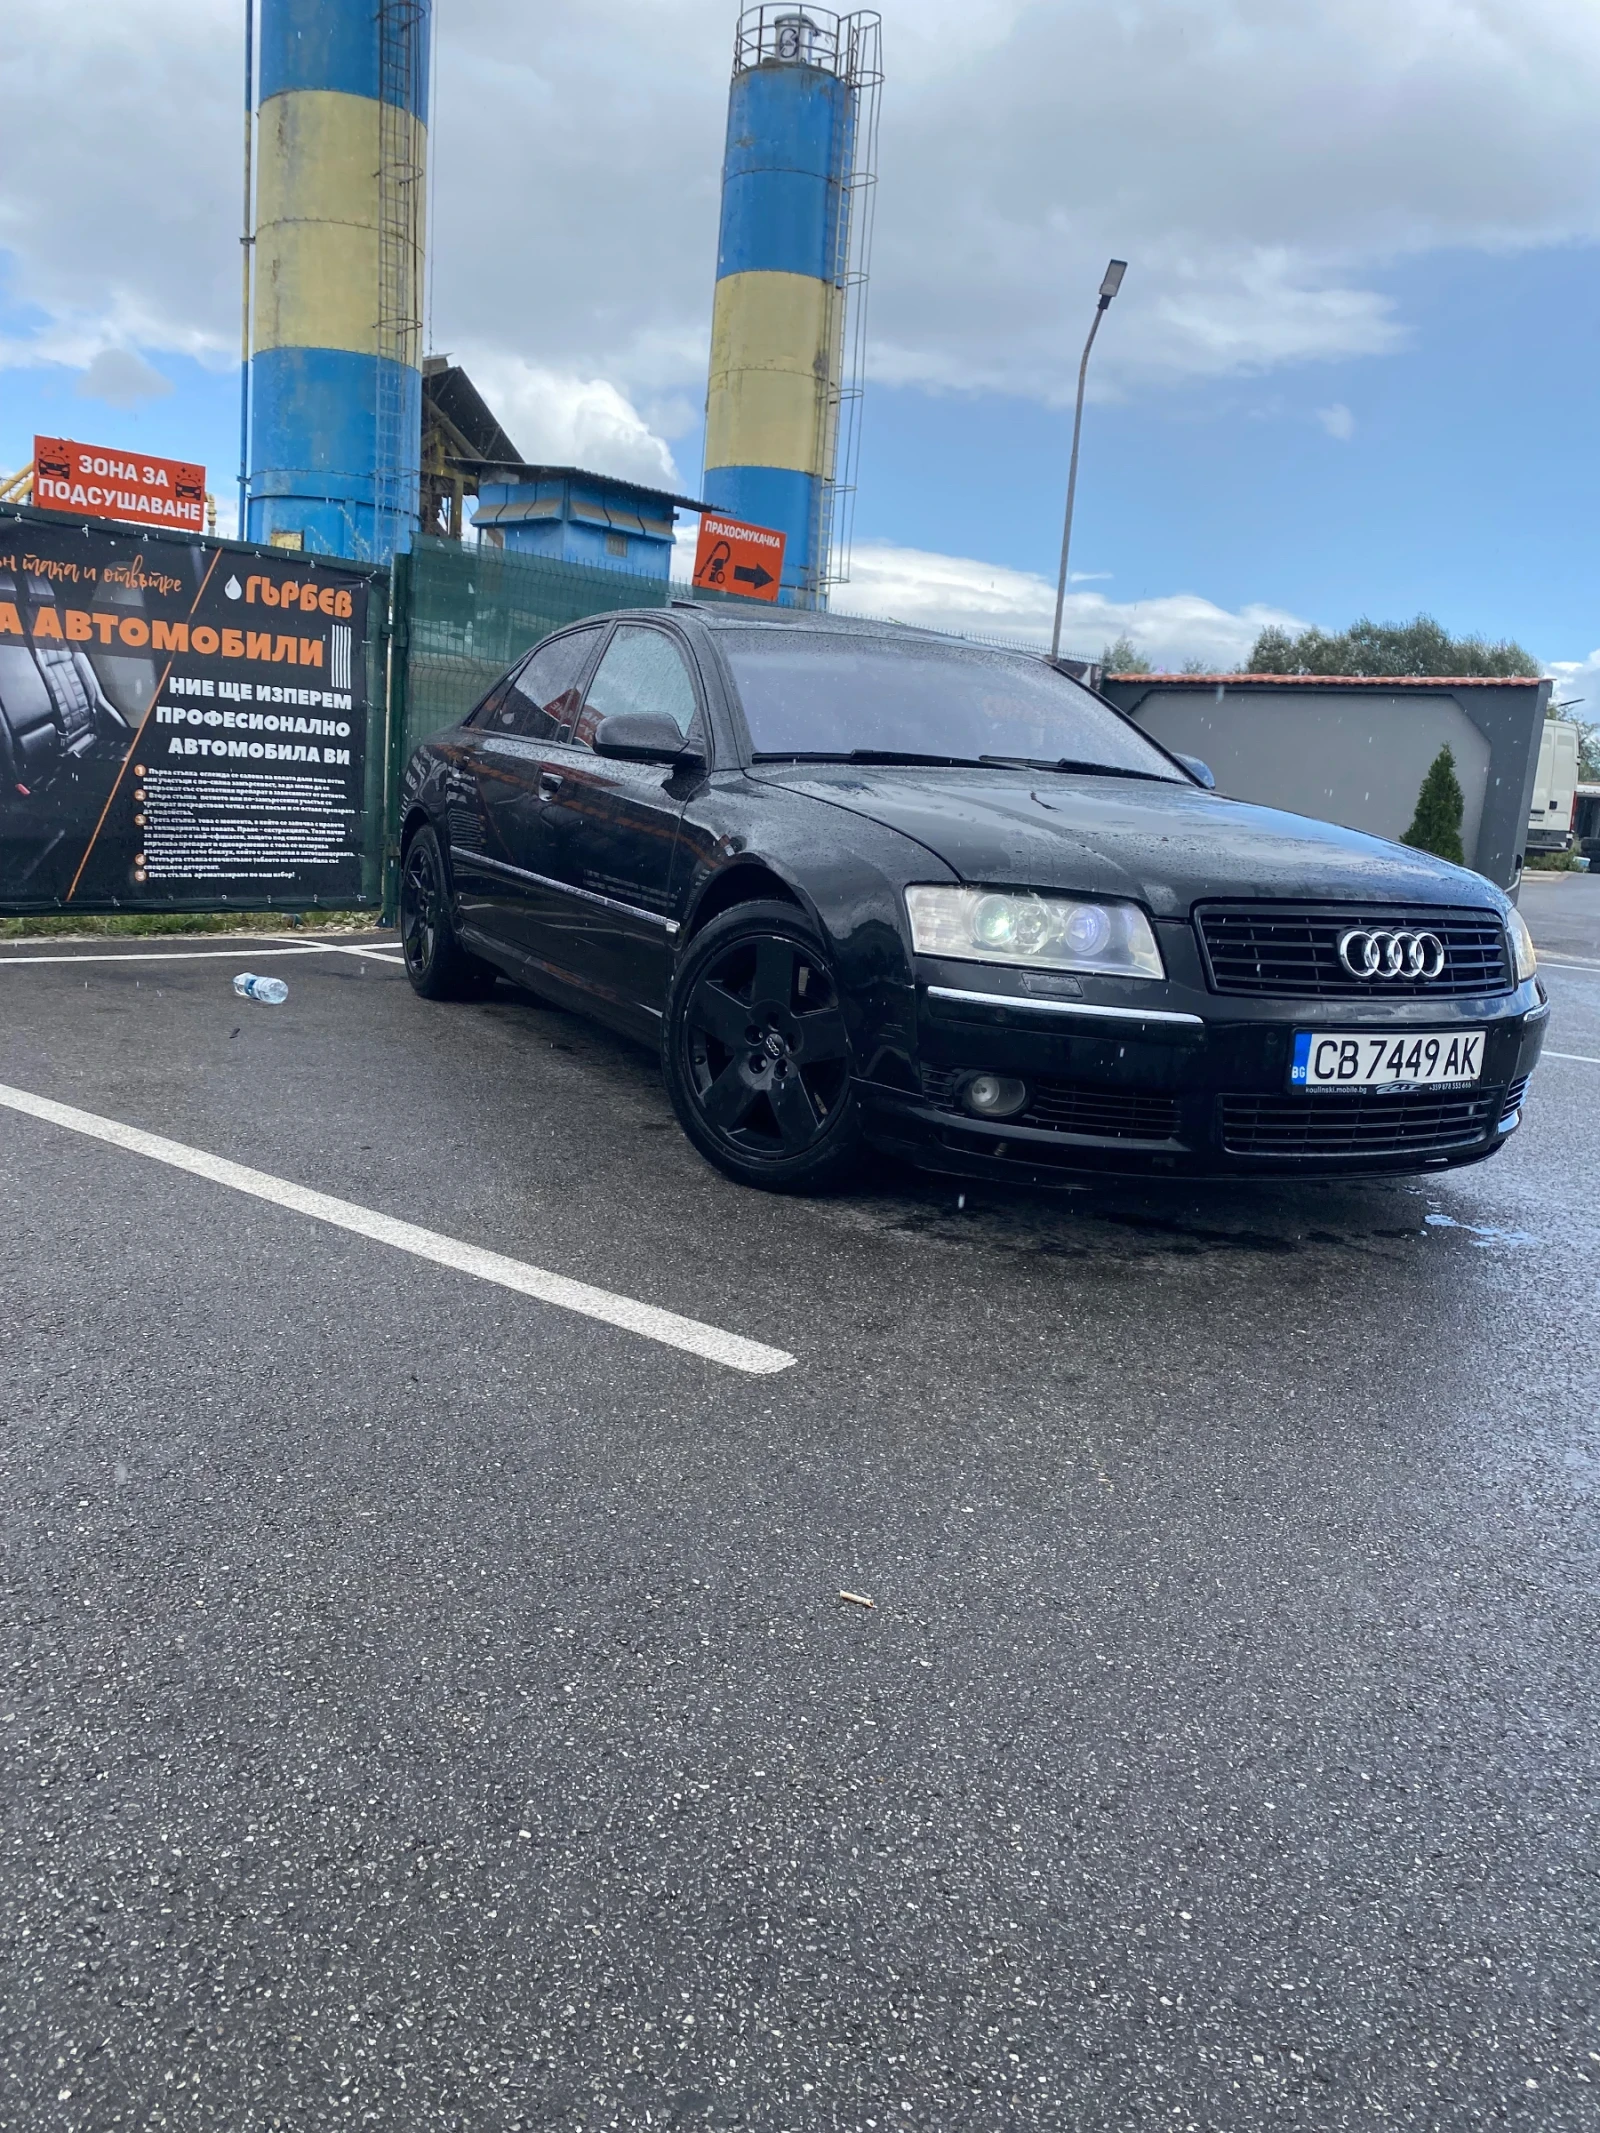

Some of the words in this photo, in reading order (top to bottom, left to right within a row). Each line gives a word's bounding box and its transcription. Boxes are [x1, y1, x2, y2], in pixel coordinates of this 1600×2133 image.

[78, 454, 138, 482] ЗОНА
[142, 466, 169, 488] ЗА
[38, 477, 201, 521] ПОДСУШАВАНЕ
[704, 520, 780, 548] ПРАХОСМУКАЧКА
[33, 606, 324, 667] АВТОМОБИЛИ
[169, 676, 215, 699] НИЕ
[218, 680, 253, 702] ЩЕ
[256, 685, 352, 710] ИЗПЕРЕМ
[155, 705, 350, 737] ПРОФЕСИОНАЛНО
[168, 737, 321, 762] АВТОМОБИЛА
[323, 747, 350, 765] ВИ
[1292, 1066, 1306, 1080] BG
